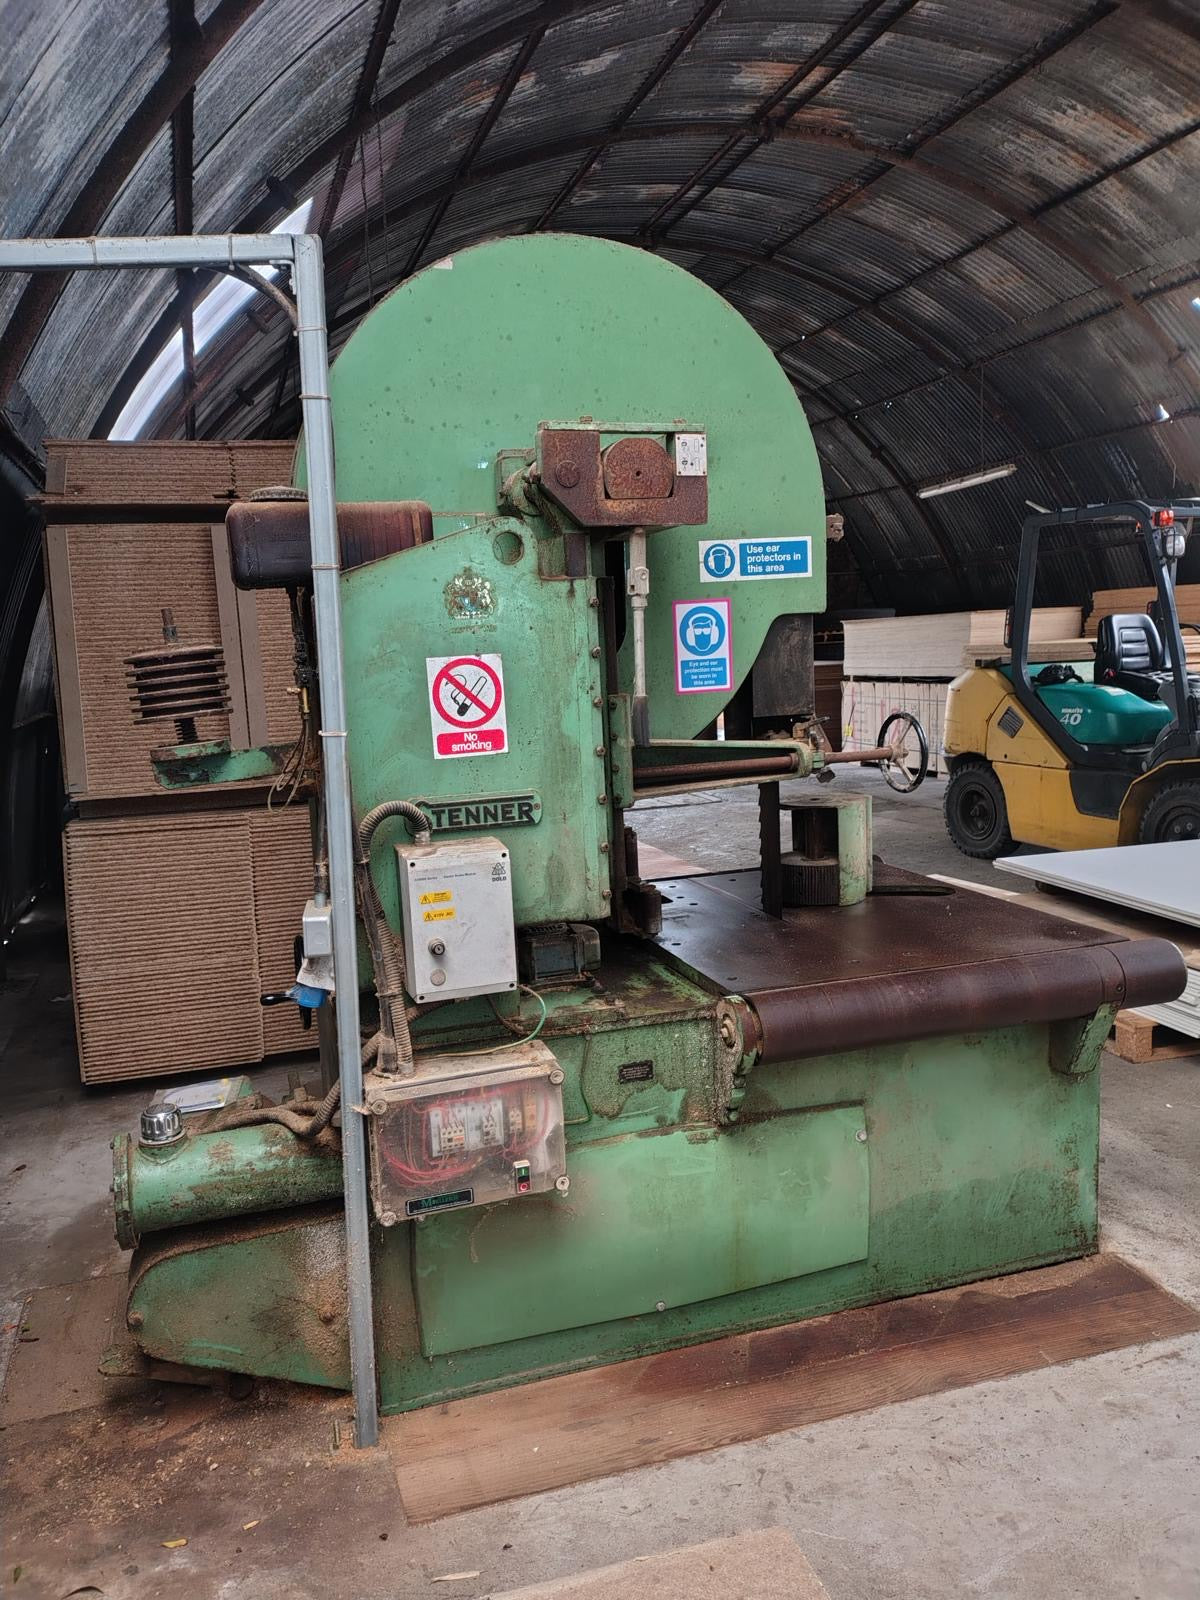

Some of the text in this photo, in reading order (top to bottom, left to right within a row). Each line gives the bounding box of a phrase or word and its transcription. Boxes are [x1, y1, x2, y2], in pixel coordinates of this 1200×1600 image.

[746, 545, 780, 554] Use ear
[746, 552, 801, 565] protectors in
[747, 564, 785, 573] this area
[1060, 713, 1082, 725] 40
[463, 732, 478, 742] No
[451, 740, 492, 751] smoking
